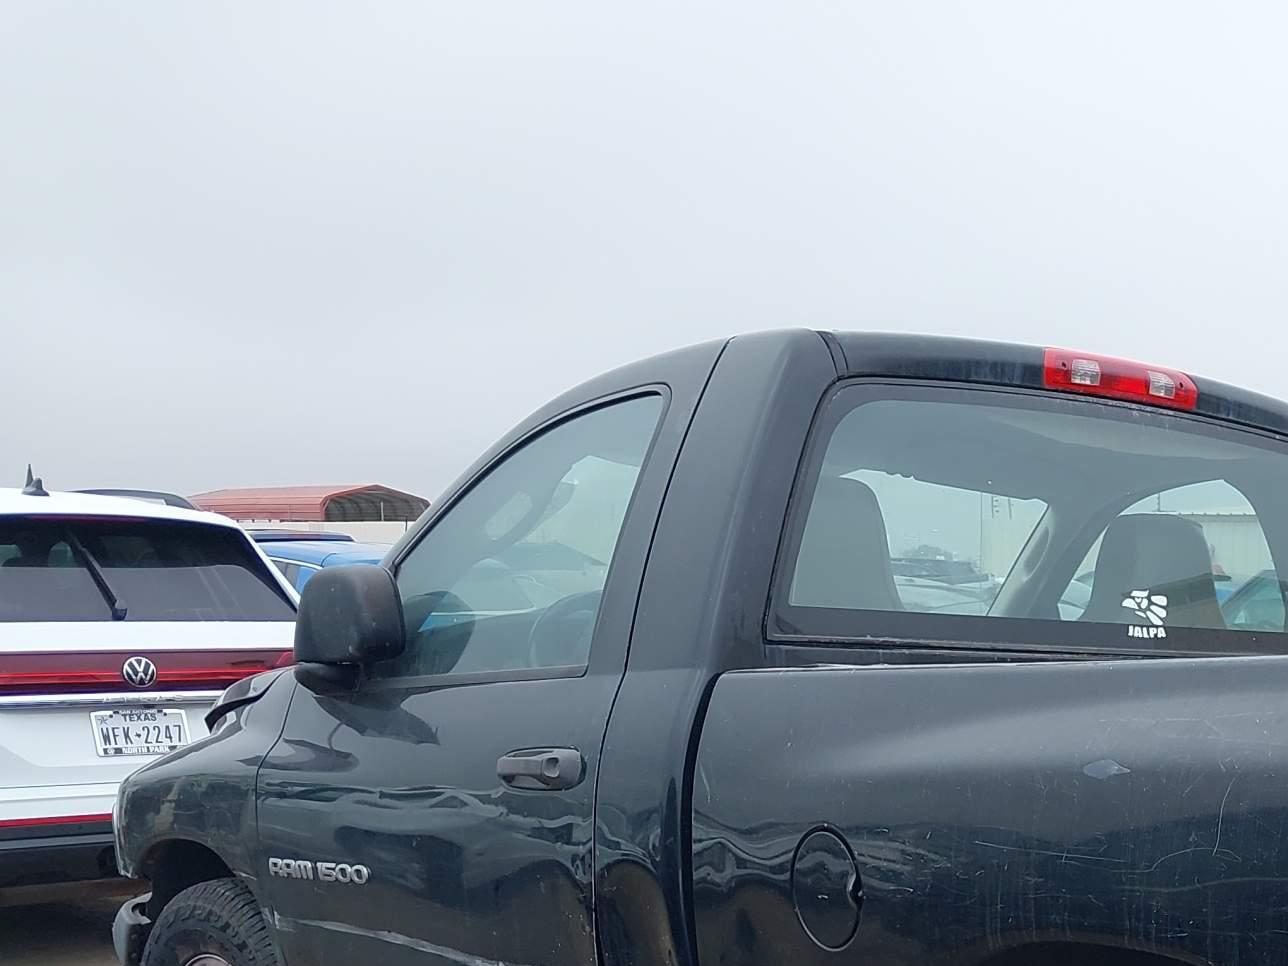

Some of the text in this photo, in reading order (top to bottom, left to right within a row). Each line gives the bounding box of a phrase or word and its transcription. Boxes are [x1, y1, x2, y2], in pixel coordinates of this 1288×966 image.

[121, 713, 157, 722] TEXAS
[149, 745, 170, 753] PARK
[268, 857, 369, 885] RAM 1500
